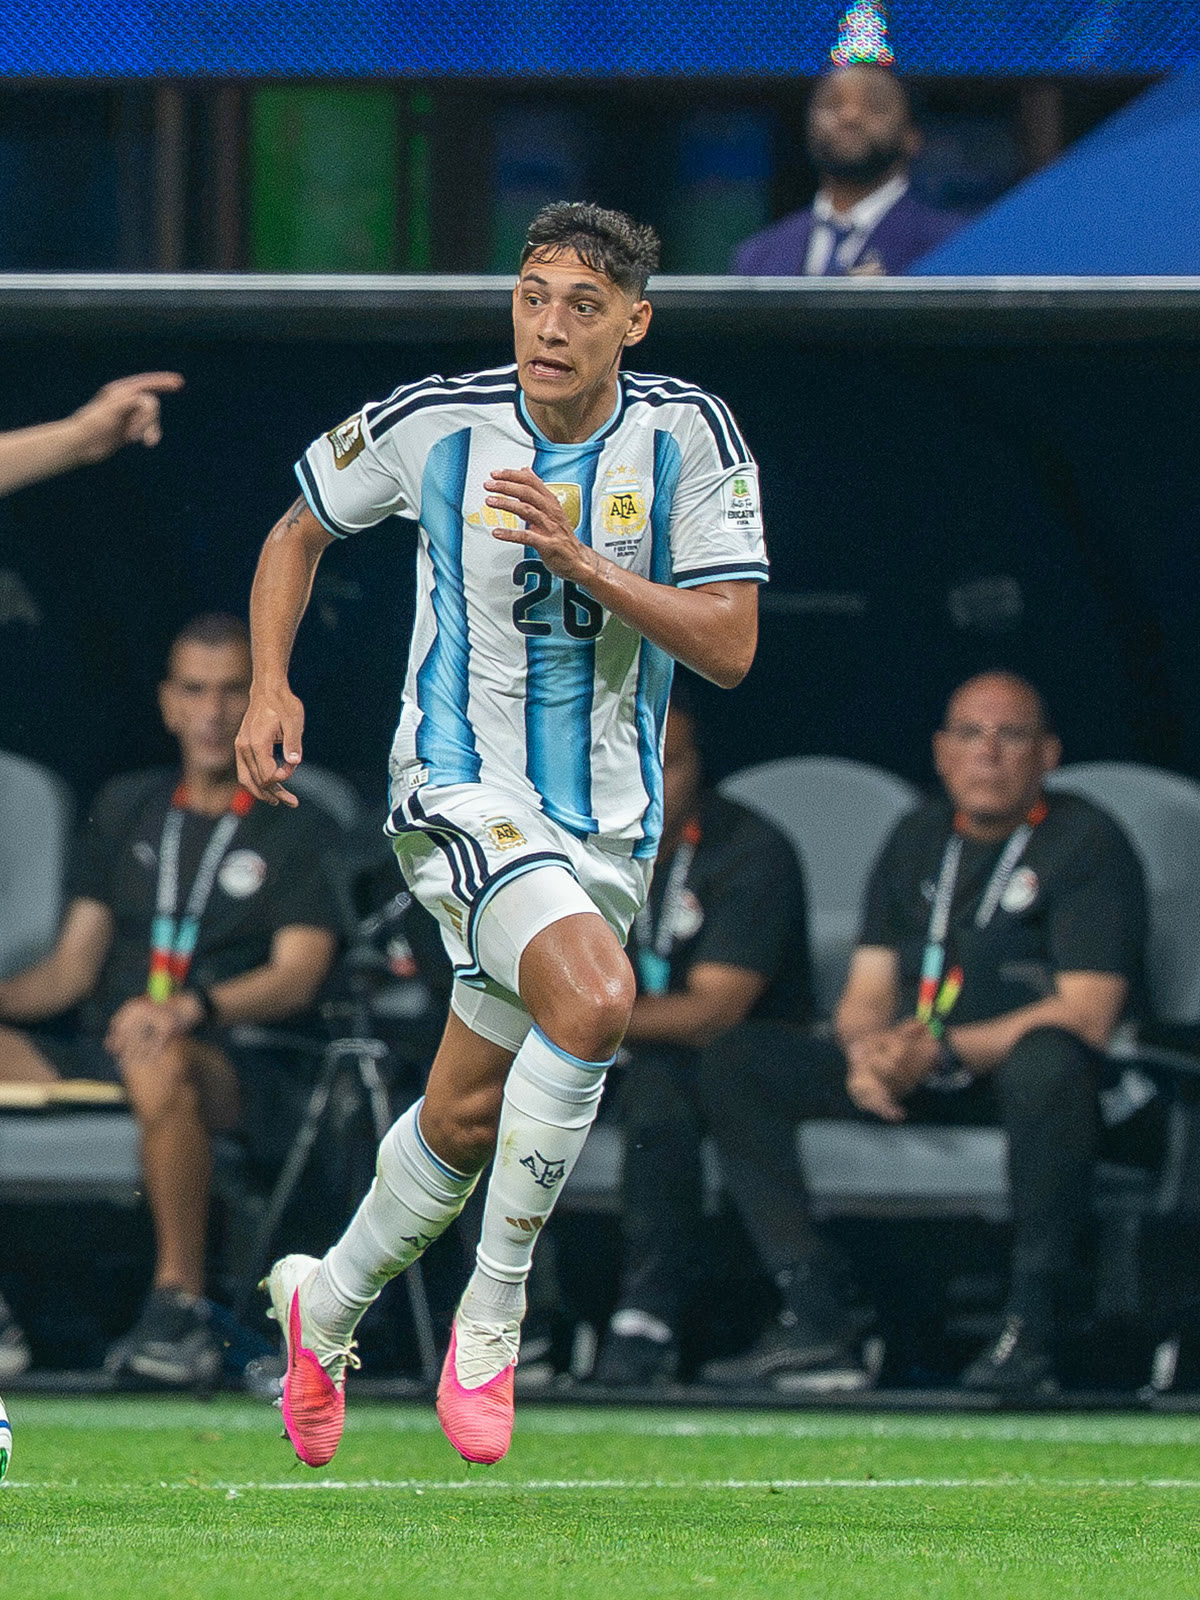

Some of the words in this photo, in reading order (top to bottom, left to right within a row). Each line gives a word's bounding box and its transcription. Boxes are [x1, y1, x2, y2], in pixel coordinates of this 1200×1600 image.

[610, 494, 637, 519] AFA
[511, 558, 604, 640] 26
[519, 1149, 566, 1188] AFA
